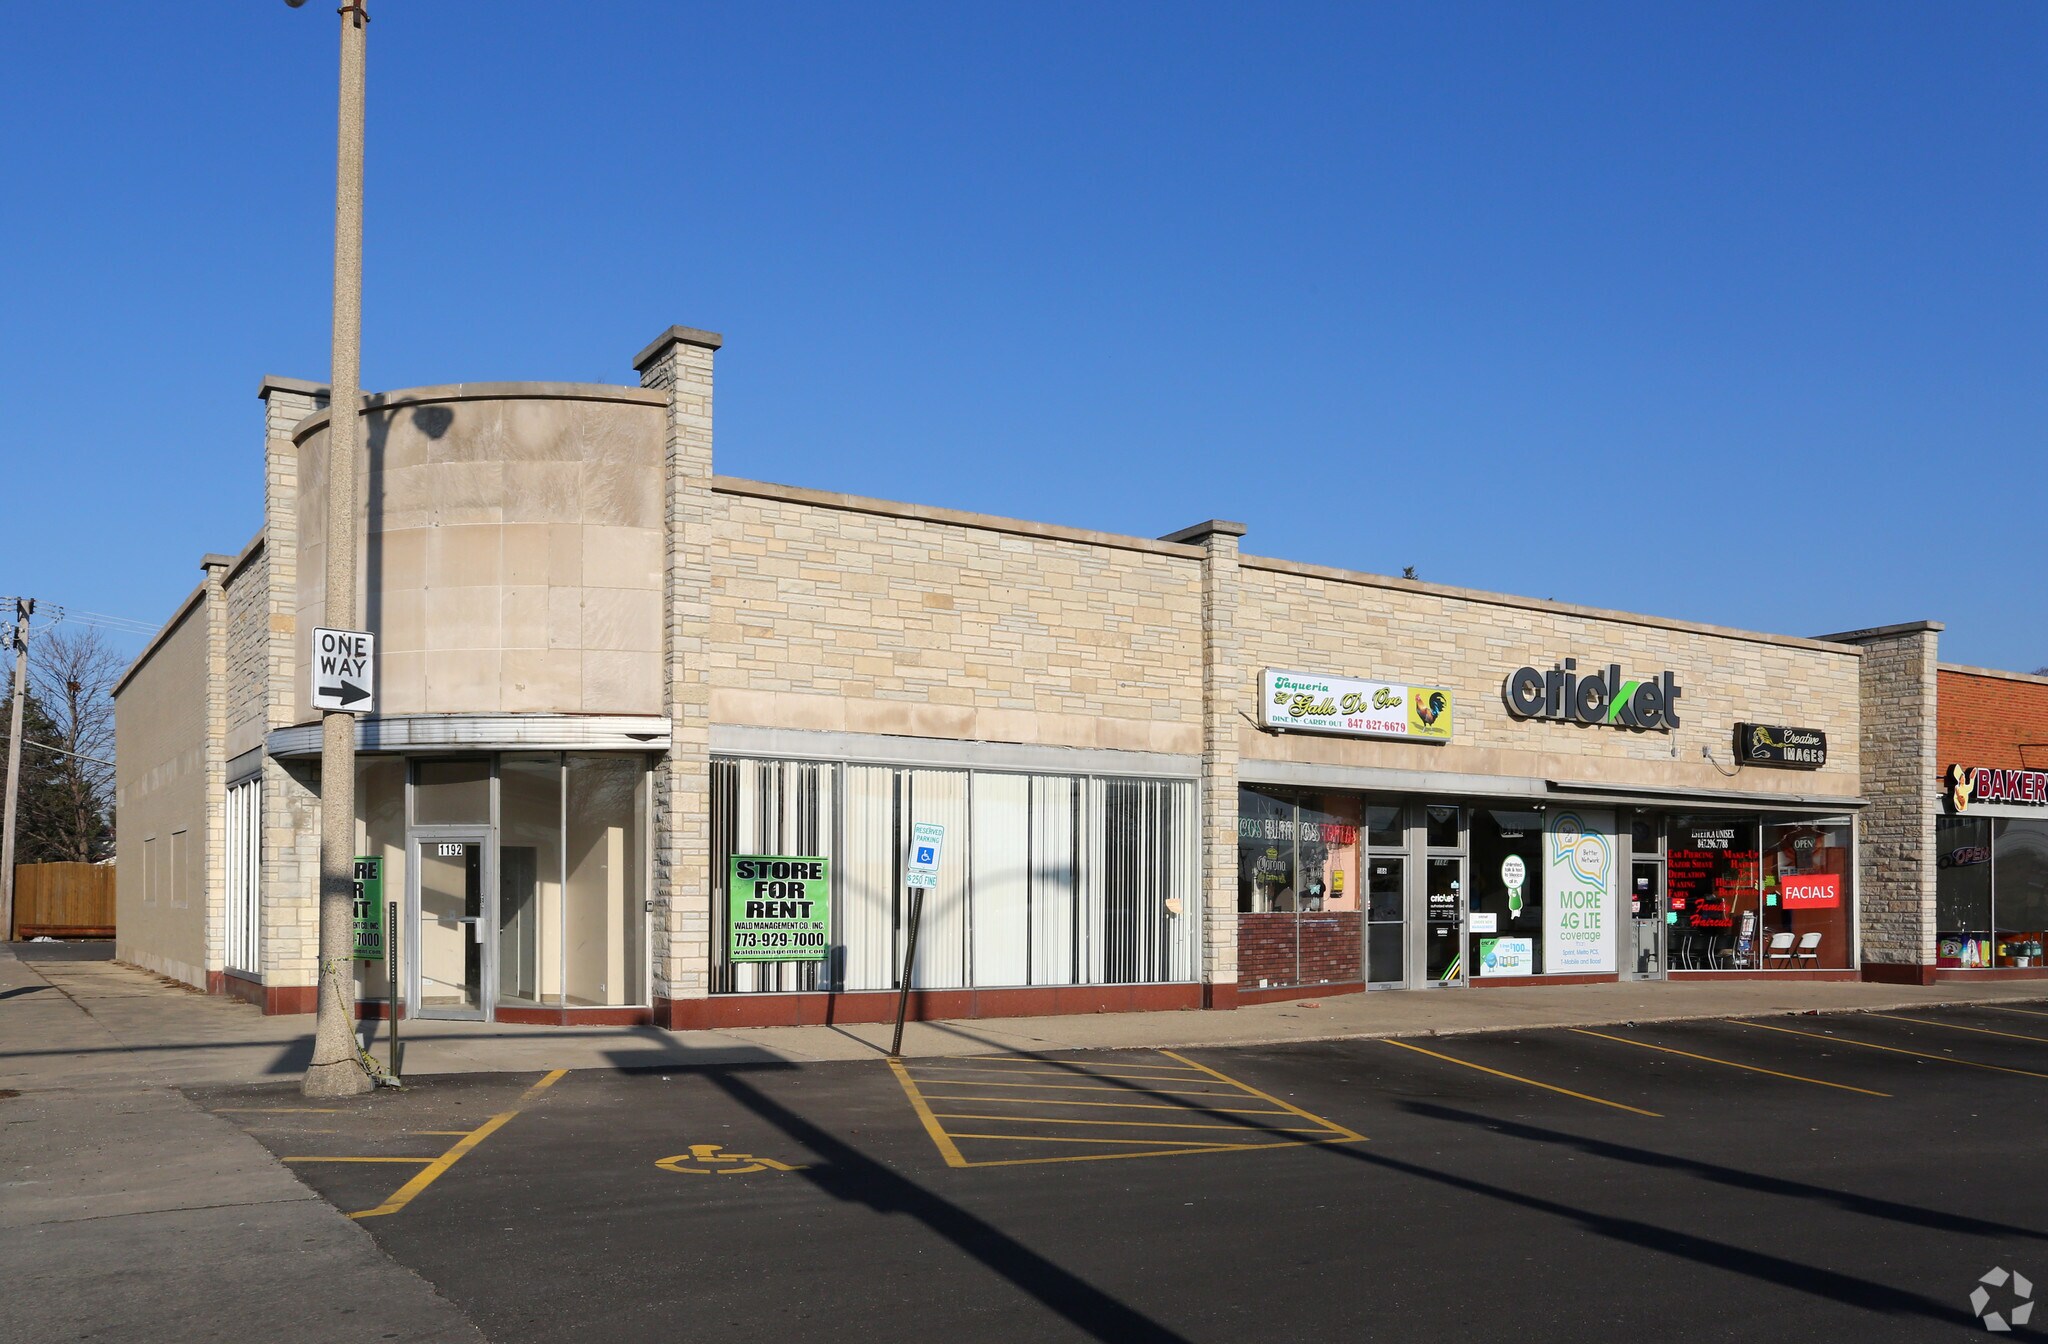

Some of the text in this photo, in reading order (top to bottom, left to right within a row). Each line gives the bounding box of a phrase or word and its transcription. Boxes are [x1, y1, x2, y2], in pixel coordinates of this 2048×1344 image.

[322, 634, 366, 657] ONE
[321, 656, 367, 677] WAY
[1274, 676, 1329, 692] Taqueria
[1508, 657, 1682, 729] cricket
[1273, 687, 1403, 717] El Gallo De Oro
[1272, 715, 1290, 723] DINE
[1303, 718, 1327, 727] CARRY
[1328, 720, 1343, 728] OUT
[1347, 718, 1406, 733] 847 827-6679
[1783, 729, 1822, 745] Creative
[1783, 747, 1825, 763] IMAGES
[915, 826, 943, 836] RESERVED
[1716, 829, 1735, 838] UNISEX
[916, 835, 940, 844] PARKING
[1794, 839, 1814, 848] OPEN
[440, 844, 462, 856] 1192
[1668, 849, 1714, 859] EAR PIERCING
[1955, 846, 1990, 865] OPEN
[736, 861, 822, 880] STORE
[1256, 855, 1286, 873] Corona
[1668, 860, 1713, 868] RAZOR SHAVE
[906, 874, 937, 886] $250 FINE
[1668, 870, 1707, 879] DEPILATION
[754, 881, 805, 899] FOR
[1668, 879, 1696, 888] WAXING
[1430, 893, 1455, 903] cricket
[1560, 890, 1601, 909] MORE
[1785, 885, 1835, 900] FACIALS
[746, 901, 814, 918] RENT
[1694, 898, 1732, 915] Family
[734, 922, 753, 930] WALD
[754, 922, 798, 930] MANAGEMENT
[812, 922, 824, 930] INC.
[1560, 912, 1601, 929] 4G LTE
[1689, 913, 1733, 927] Haircuts
[735, 932, 824, 947] 773-929-7000
[1560, 931, 1601, 942] coverage
[1510, 943, 1525, 953] $100
